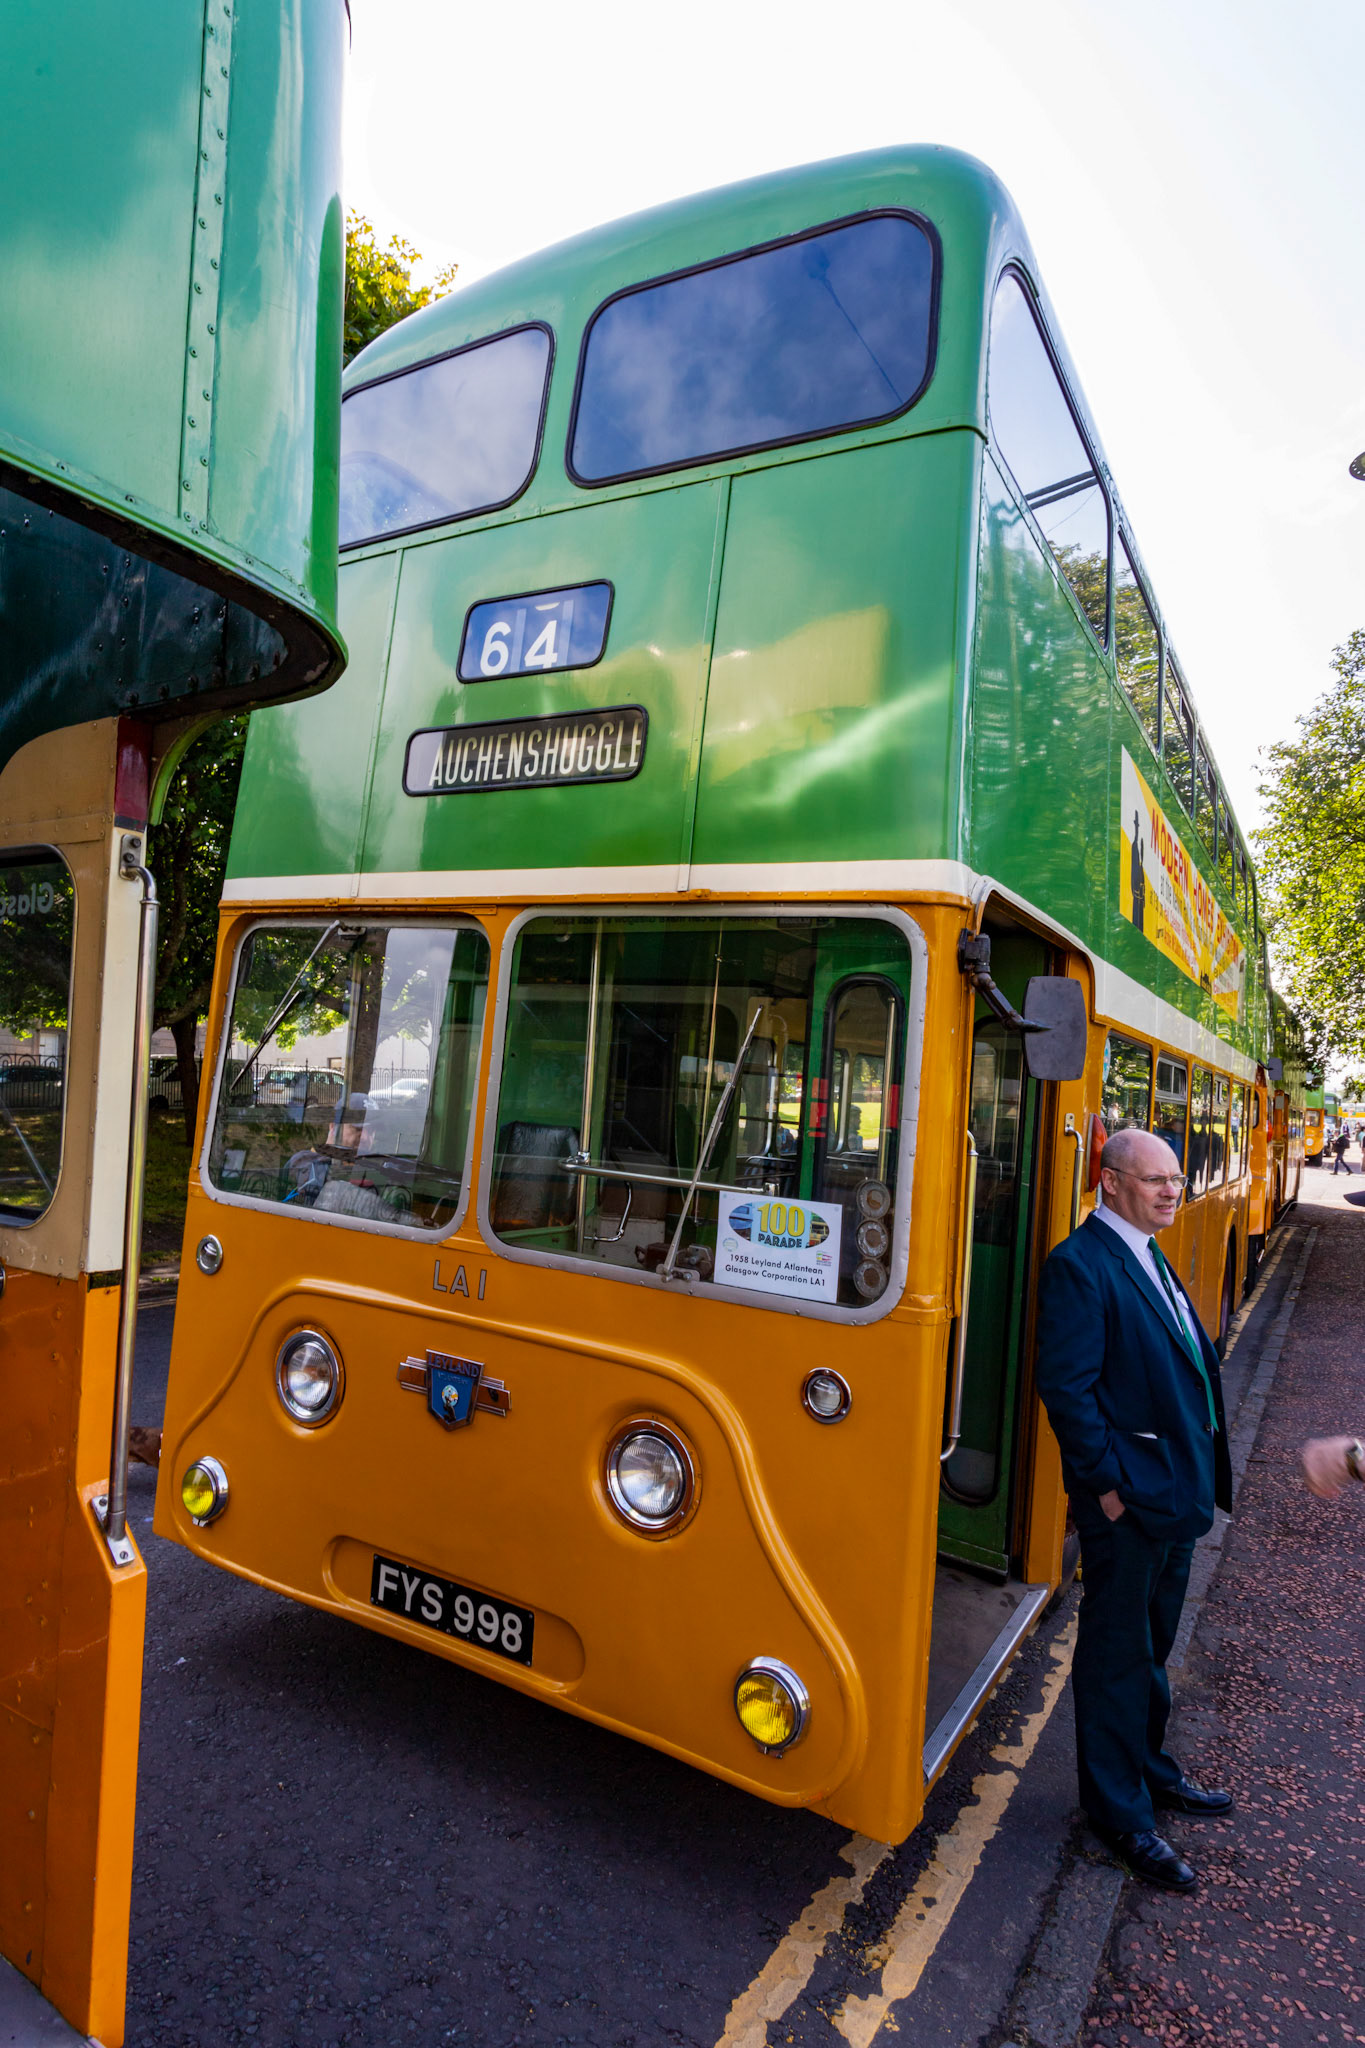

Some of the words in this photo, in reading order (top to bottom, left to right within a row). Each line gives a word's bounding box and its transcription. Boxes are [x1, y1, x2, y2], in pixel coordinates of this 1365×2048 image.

[480, 620, 557, 676] 64
[430, 719, 642, 786] AUCHENSHUGGLE
[1151, 808, 1188, 897] MODERN
[1193, 871, 1213, 934] HOMES
[758, 1203, 805, 1237] 100
[758, 1233, 802, 1248] PARADE
[725, 1264, 759, 1276] Glasgow
[761, 1270, 808, 1284] Corporation
[810, 1277, 825, 1286] LA1
[730, 1254, 749, 1263] 1958
[751, 1257, 782, 1268] Leyland
[784, 1262, 823, 1275] Atlantean
[428, 1352, 480, 1378] LEYLAND
[378, 1563, 443, 1621] FYS
[454, 1595, 522, 1652] 998
